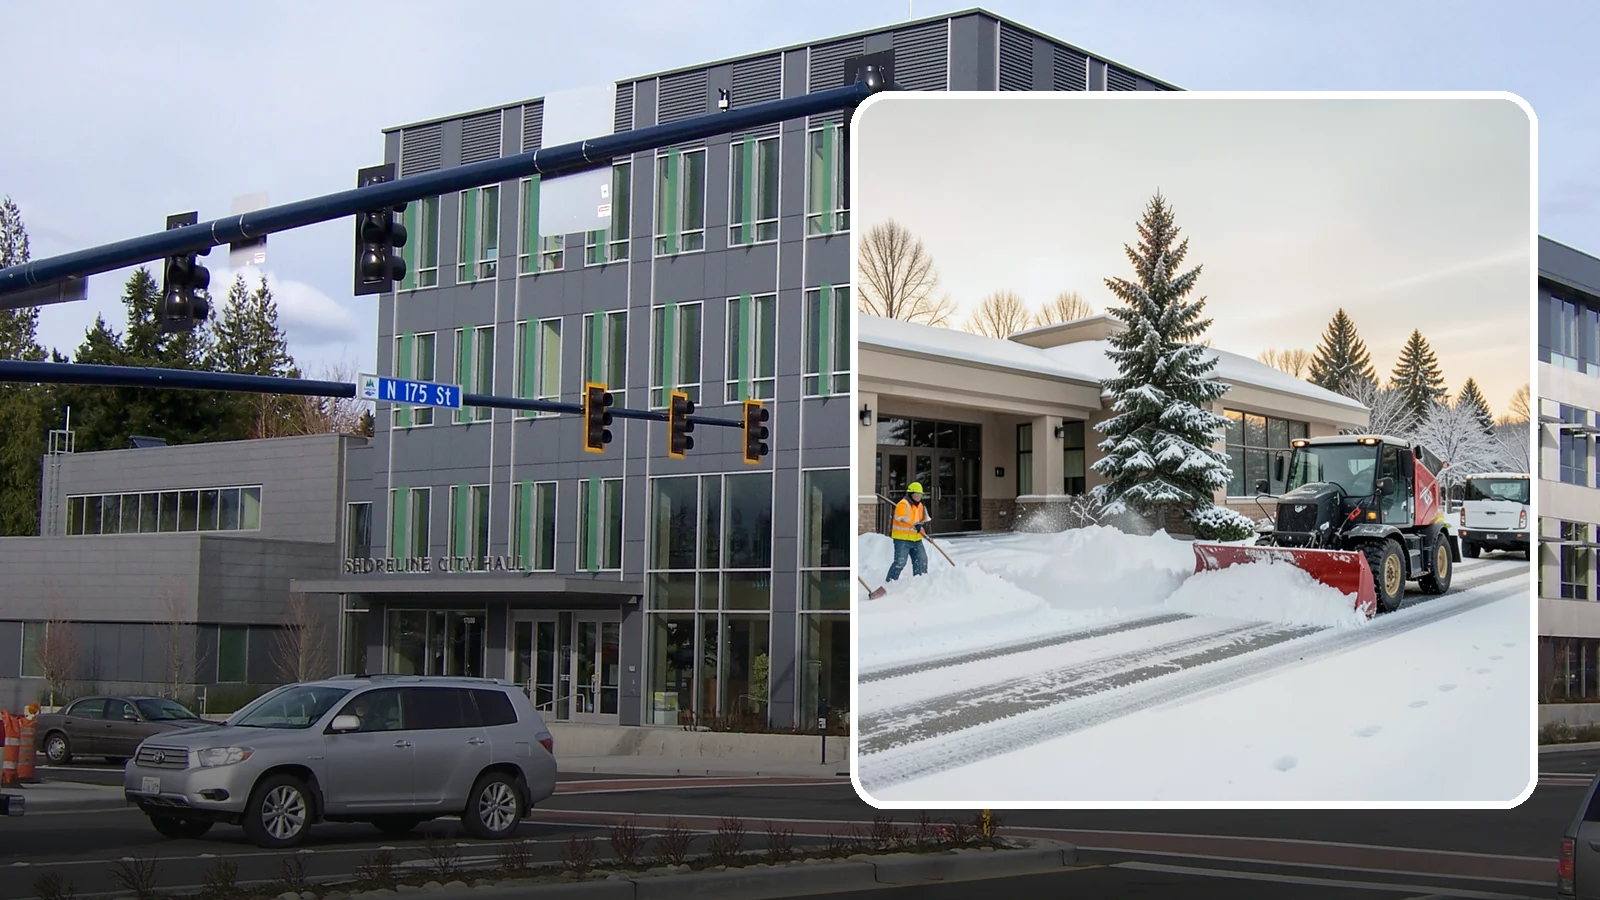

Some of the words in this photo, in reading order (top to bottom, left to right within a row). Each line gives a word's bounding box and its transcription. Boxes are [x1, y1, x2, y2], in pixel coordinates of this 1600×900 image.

[387, 380, 396, 399] N
[405, 382, 427, 403] 175
[436, 386, 451, 406] St
[343, 557, 432, 574] SHORELINE
[438, 556, 475, 572] CITY
[484, 556, 525, 571] HALL
